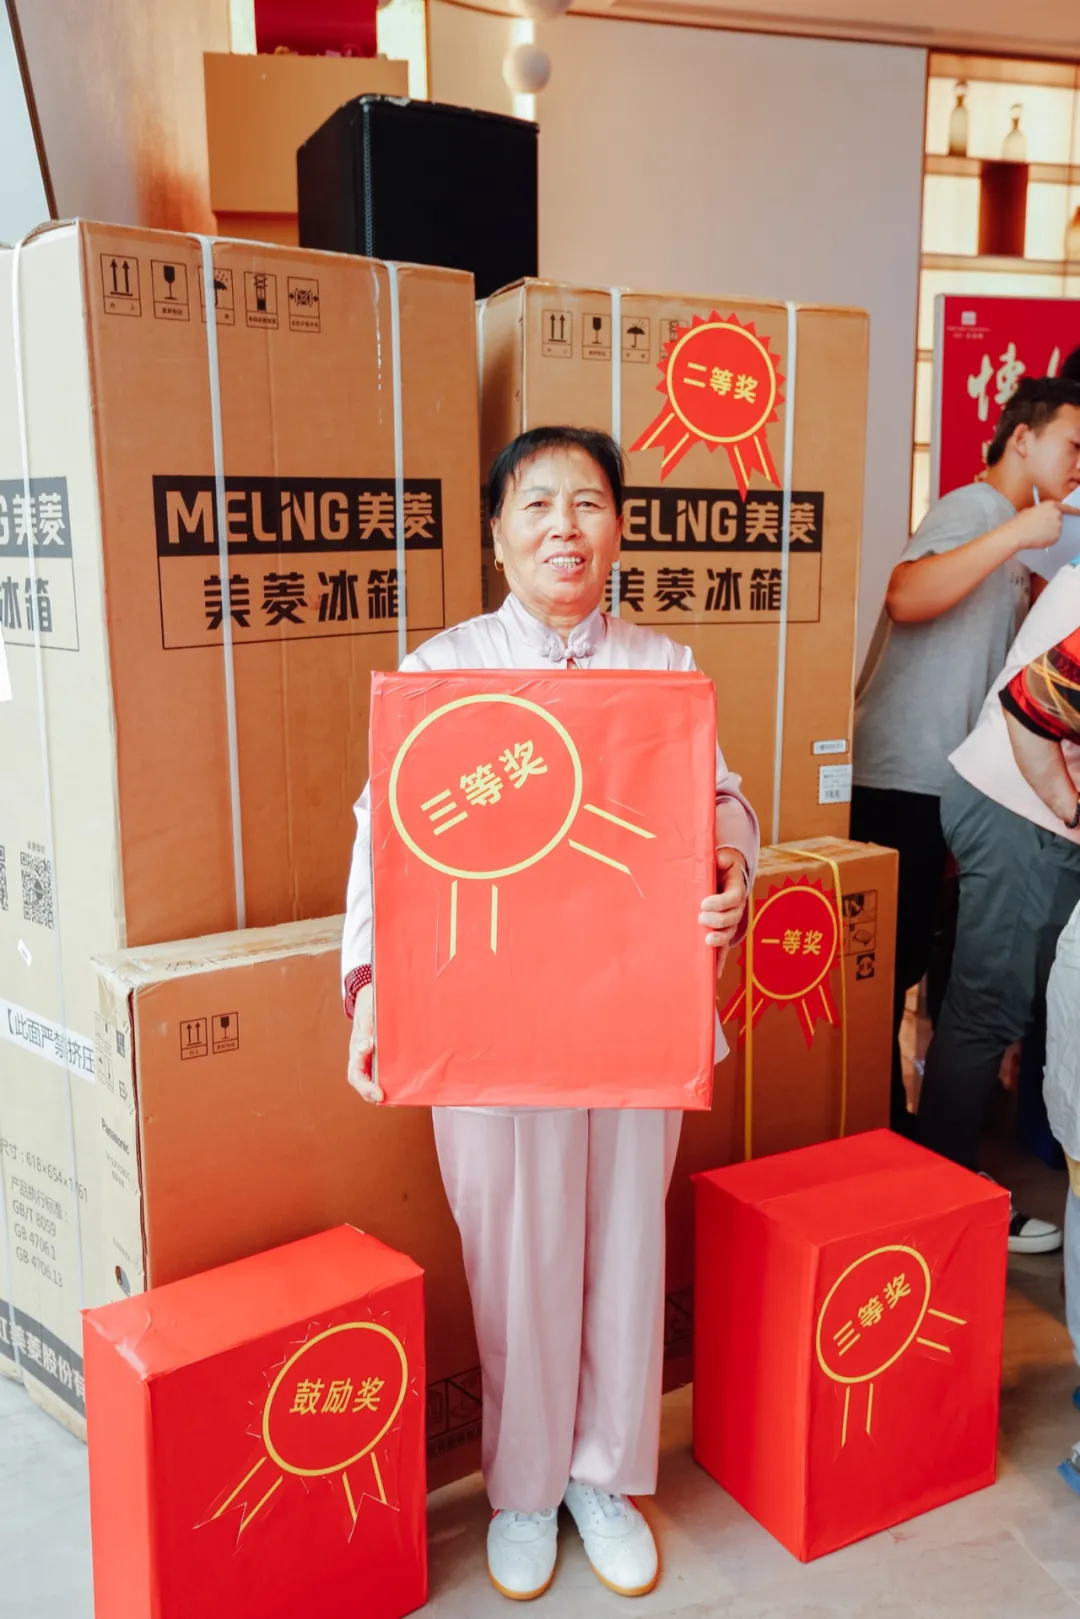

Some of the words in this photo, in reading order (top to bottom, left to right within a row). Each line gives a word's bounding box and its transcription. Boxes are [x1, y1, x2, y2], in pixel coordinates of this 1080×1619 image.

[683, 361, 760, 404] 二等奖
[358, 491, 436, 541] 美菱
[745, 500, 817, 544] 美菱
[203, 568, 408, 631] 美菱冰箱
[604, 566, 785, 613] 美菱冰箱
[420, 739, 548, 837] 三等奖
[761, 929, 824, 956] 一等奖
[12, 1199, 33, 1223] GB/T
[14, 1222, 27, 1241] GB
[15, 1245, 29, 1264] GB
[833, 1271, 912, 1357] 三等奖
[289, 1376, 385, 1416] 鼓励奖
